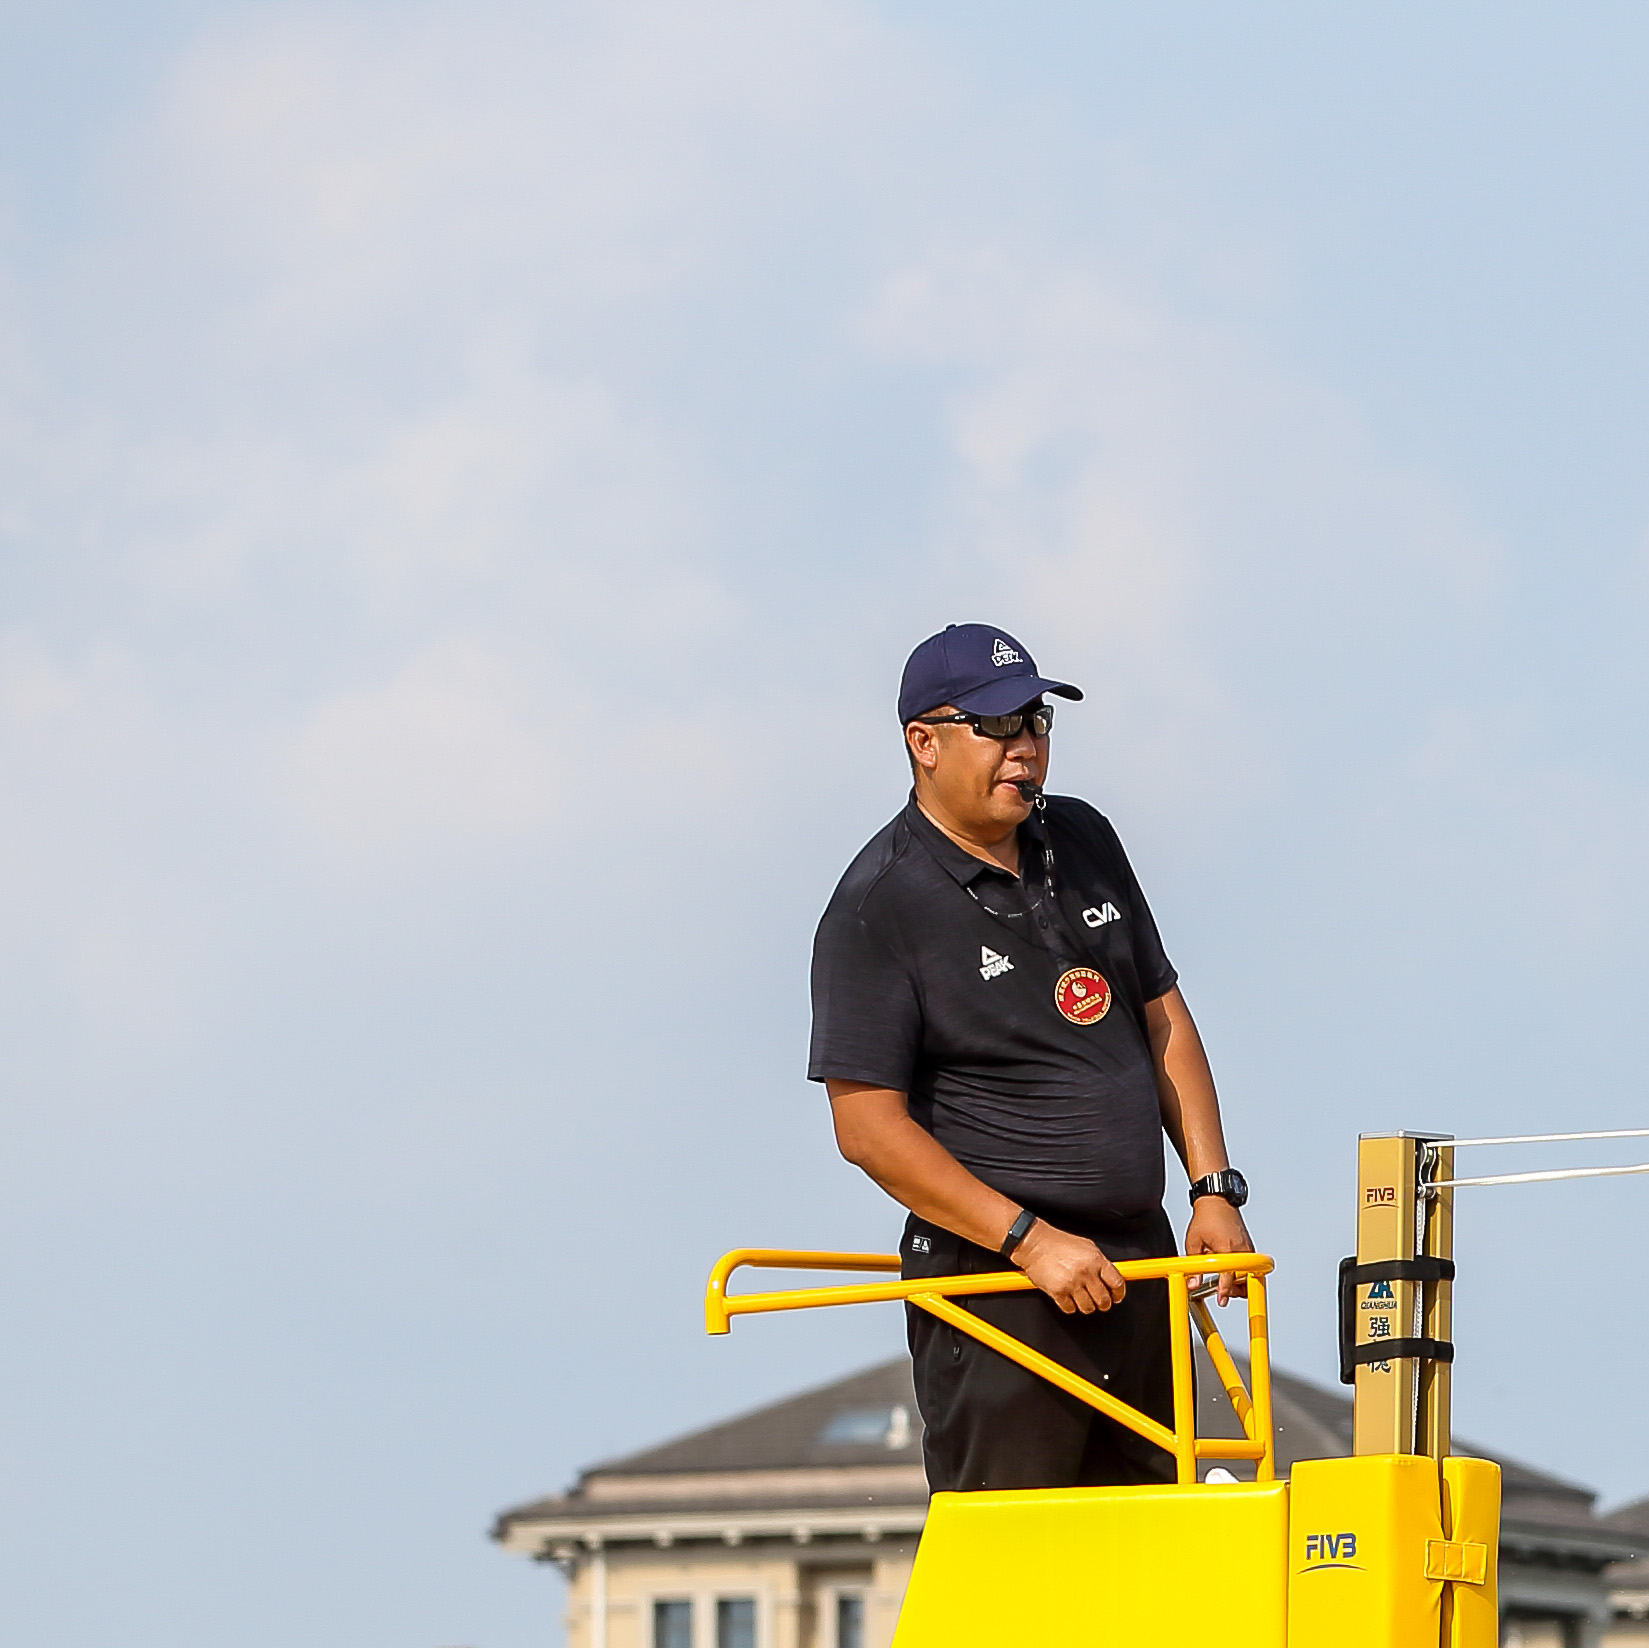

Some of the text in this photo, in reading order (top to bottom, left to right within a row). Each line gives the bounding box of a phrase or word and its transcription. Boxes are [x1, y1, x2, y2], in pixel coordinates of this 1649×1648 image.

[1082, 901, 1122, 928] CVA
[979, 955, 1015, 981] PEAK
[1366, 1187, 1396, 1203] FIVB
[1305, 1532, 1357, 1560] FIVB
